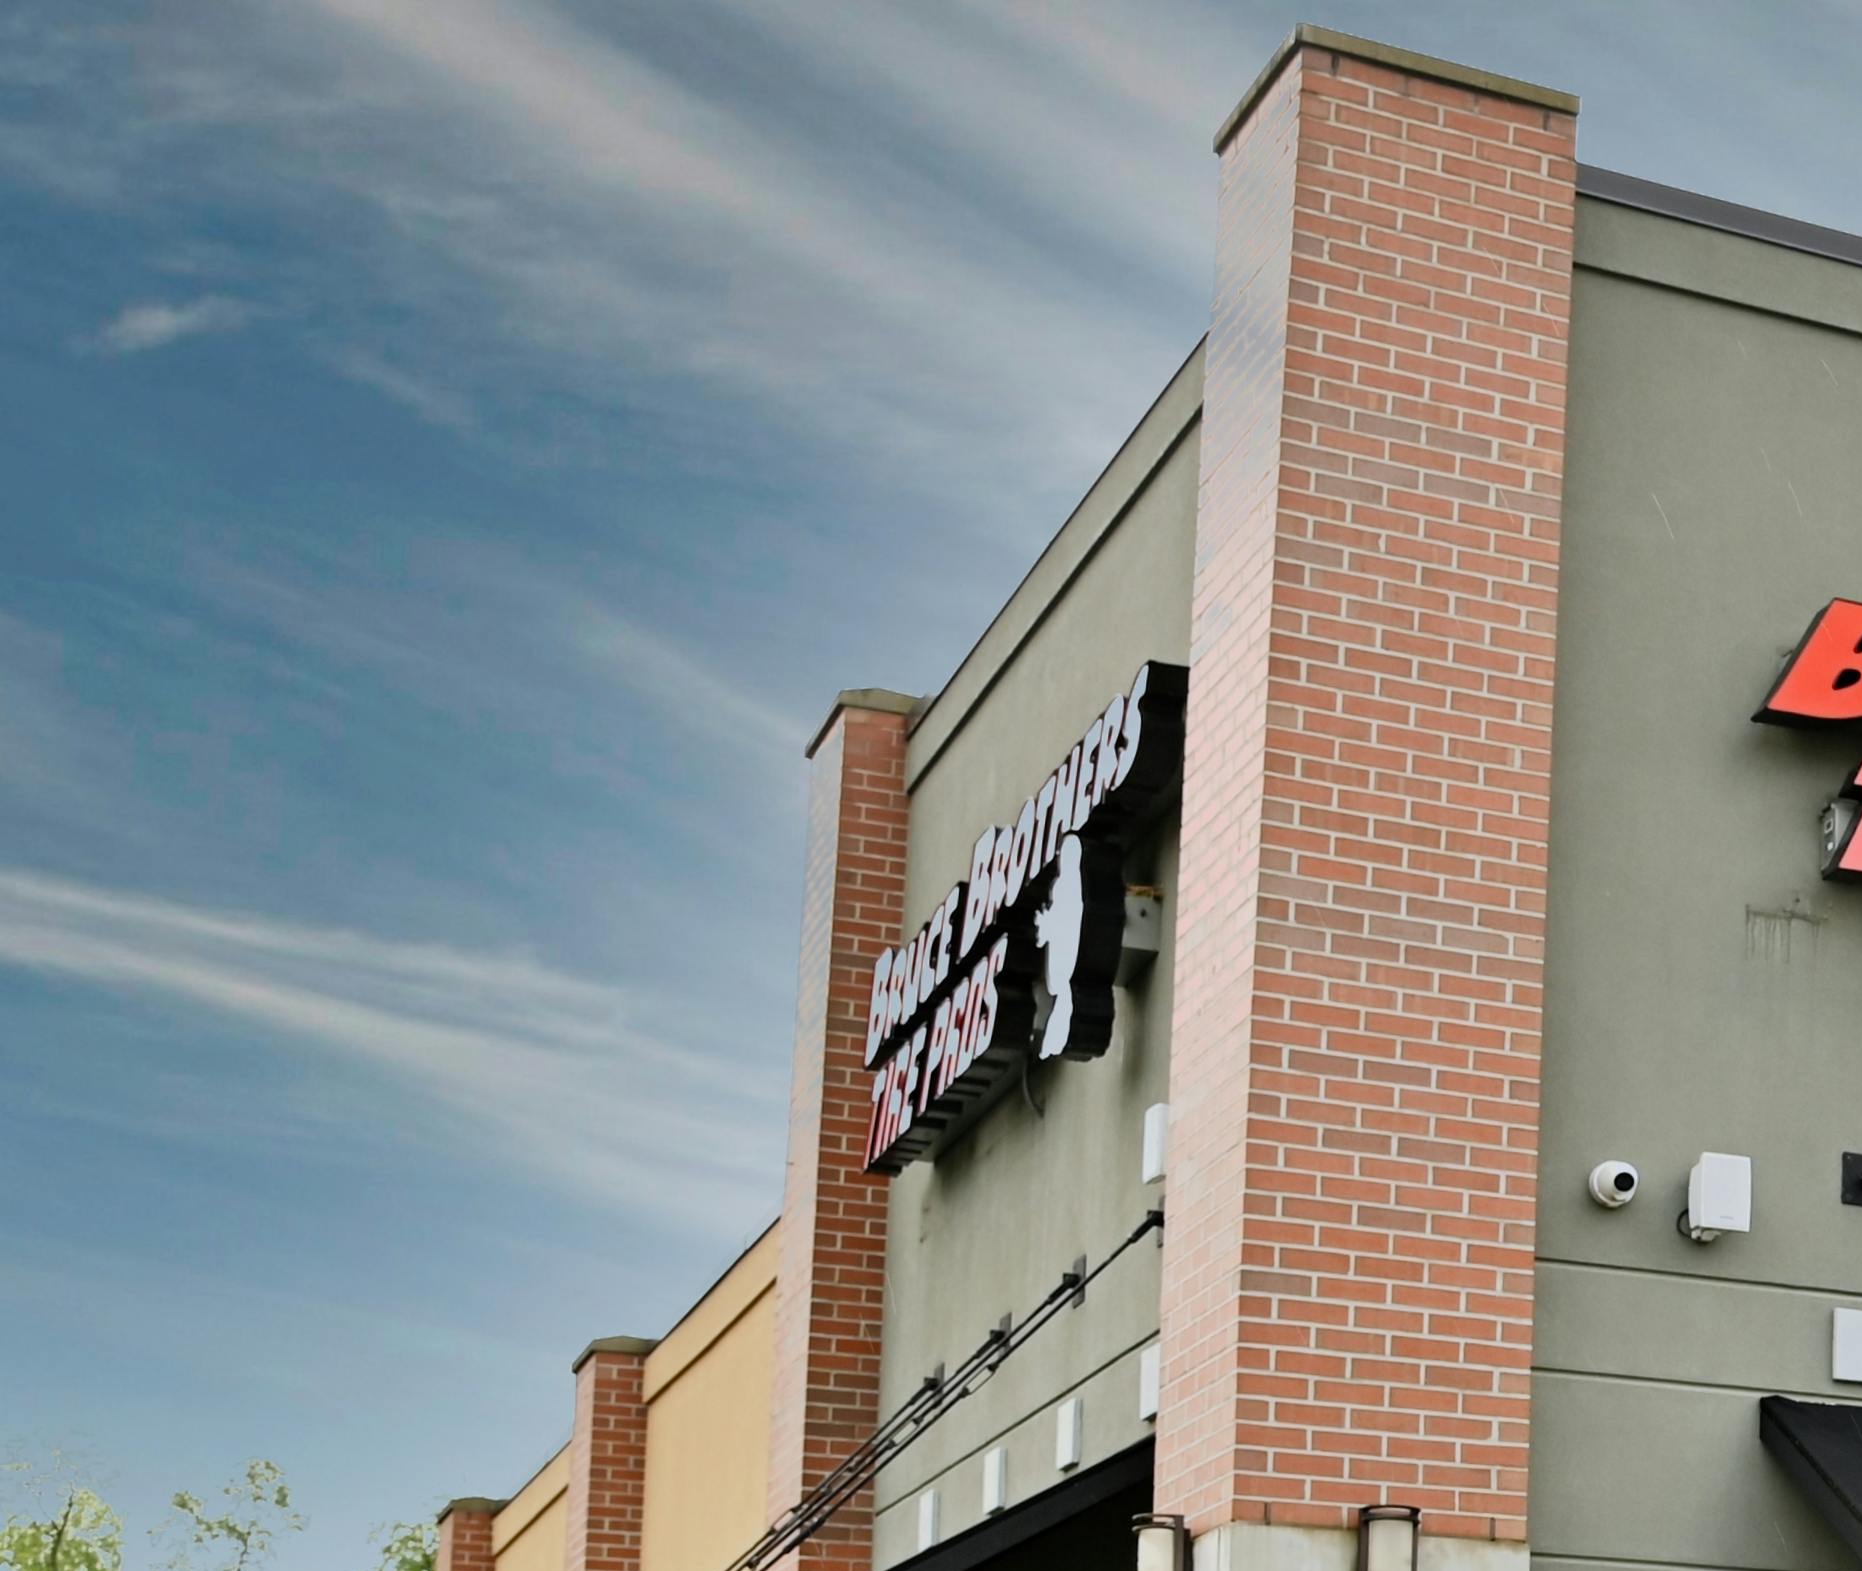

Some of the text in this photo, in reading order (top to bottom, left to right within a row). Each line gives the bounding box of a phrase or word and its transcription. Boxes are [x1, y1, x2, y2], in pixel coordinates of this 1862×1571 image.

[864, 664, 1150, 1066] BRUCE BROTHERS
[862, 932, 1008, 1172] TIRE PROS
